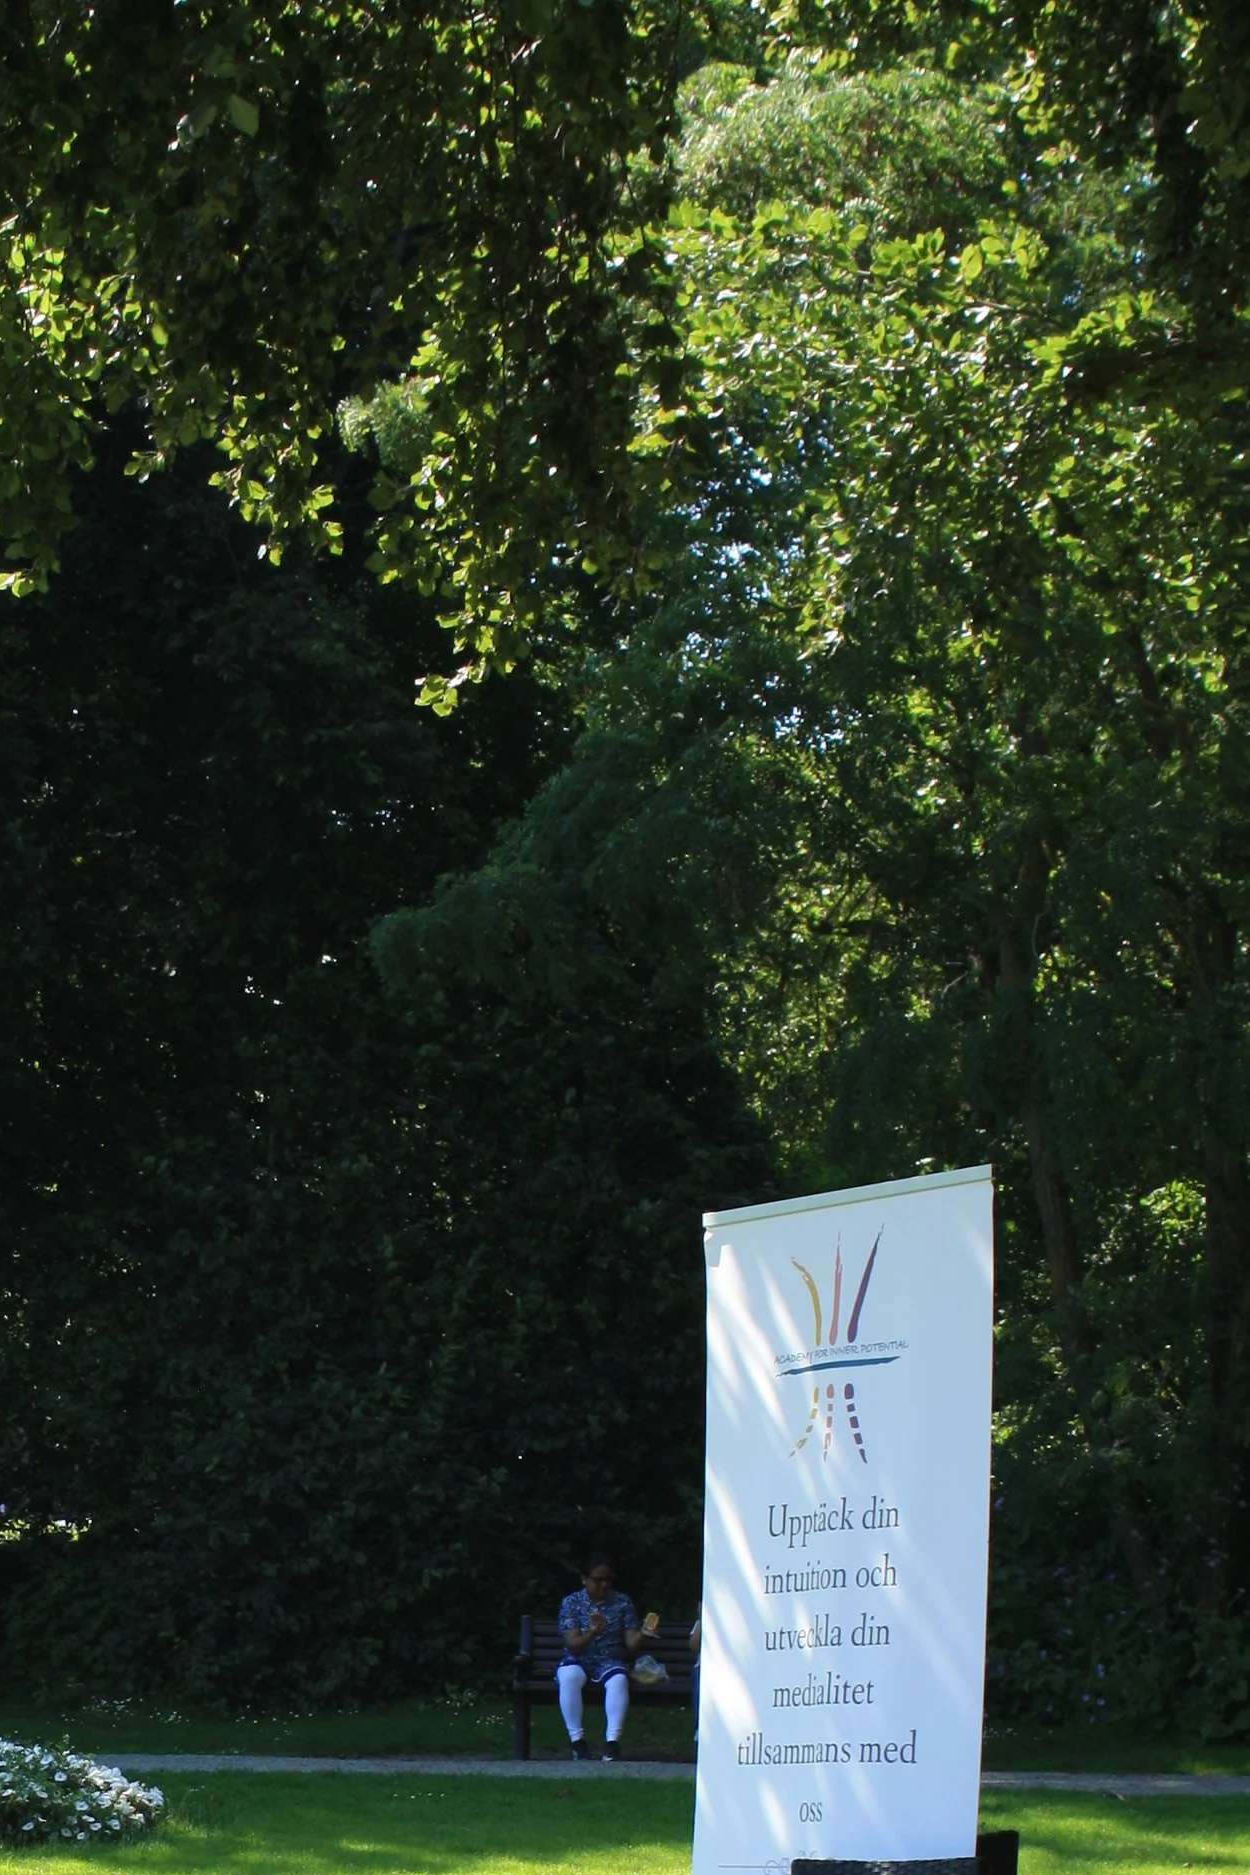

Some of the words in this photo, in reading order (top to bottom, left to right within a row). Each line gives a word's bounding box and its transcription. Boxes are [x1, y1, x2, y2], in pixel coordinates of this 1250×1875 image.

[773, 1350, 814, 1365] ACADEMY
[814, 1348, 829, 1359] FOR
[829, 1345, 858, 1357] INNER
[860, 1340, 909, 1354] POTENTIAL
[767, 1496, 854, 1549] Upptäck
[862, 1495, 900, 1531] din
[763, 1560, 847, 1595] intuition
[855, 1552, 898, 1588] och
[764, 1613, 842, 1651] utveckla
[851, 1612, 891, 1647] din
[772, 1671, 874, 1708] medialitet
[737, 1732, 851, 1766] tillsammans
[858, 1729, 918, 1765] med
[799, 1801, 823, 1823] oss
